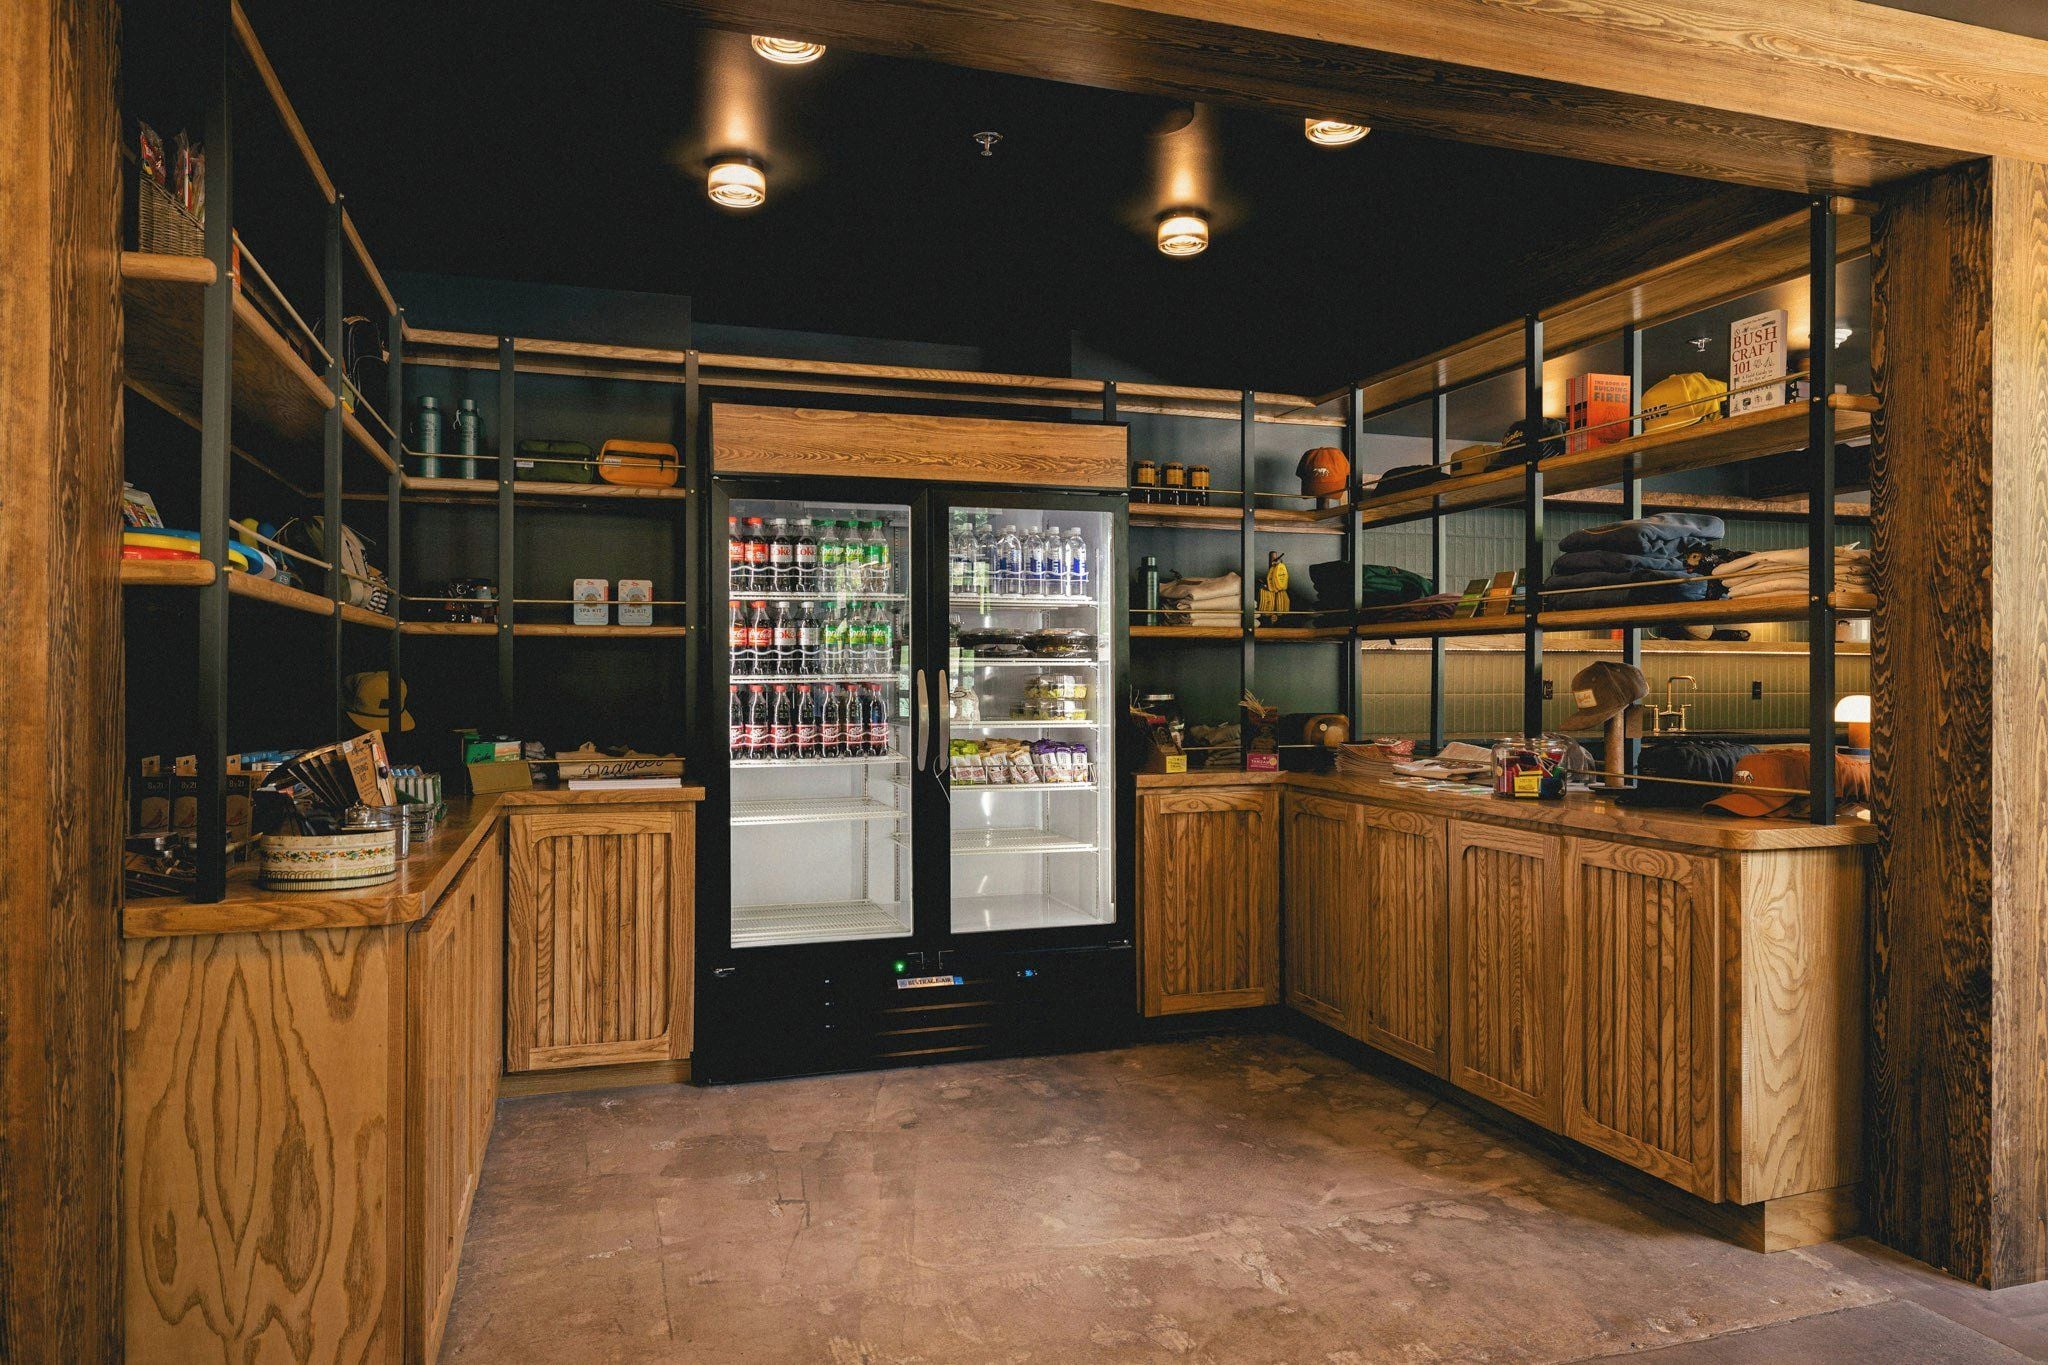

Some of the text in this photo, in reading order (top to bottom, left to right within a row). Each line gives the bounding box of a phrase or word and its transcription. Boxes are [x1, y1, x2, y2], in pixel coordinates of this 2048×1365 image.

[1733, 326, 1778, 350] BUSH
[1732, 340, 1777, 363] CRAFT
[1734, 361, 1751, 376] 101
[1593, 385, 1628, 393] BUILDING
[1593, 392, 1628, 403] FIRES
